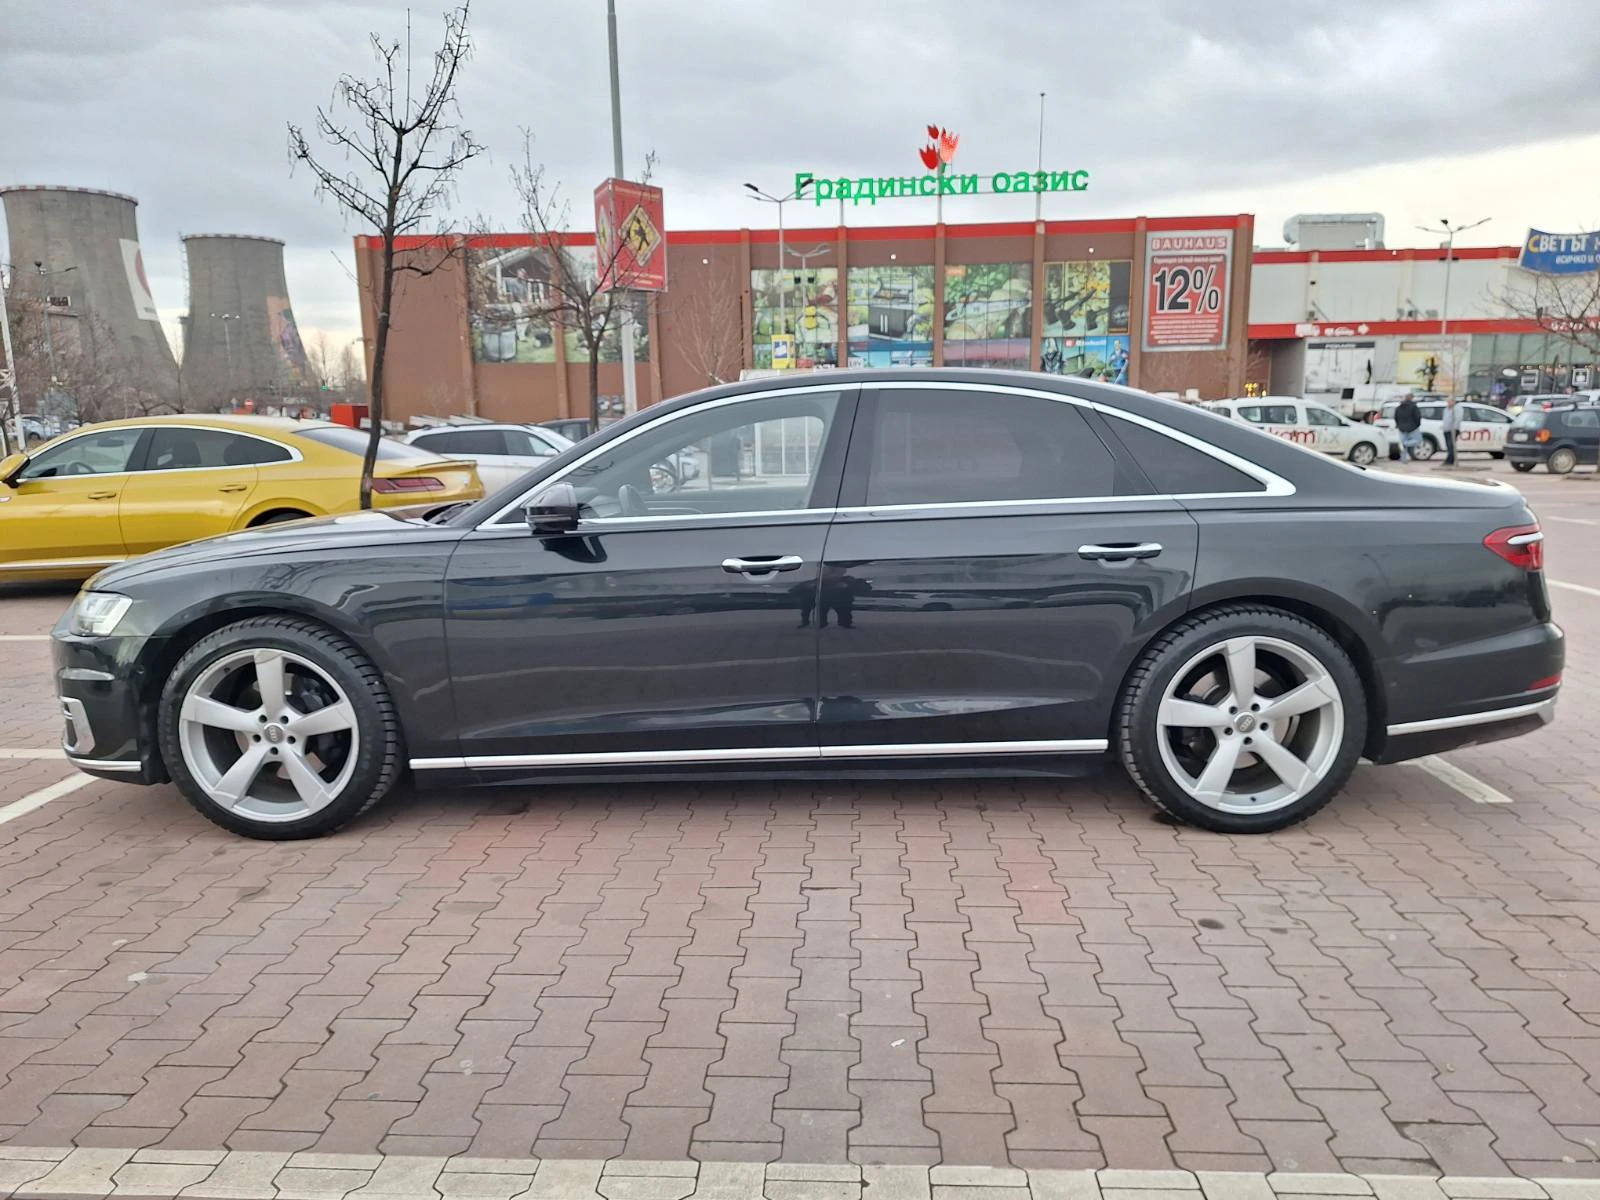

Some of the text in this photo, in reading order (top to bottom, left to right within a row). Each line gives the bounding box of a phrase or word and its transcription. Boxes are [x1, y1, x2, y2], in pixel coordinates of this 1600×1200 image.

[795, 170, 1089, 206] Градински оазис
[1152, 237, 1227, 250] BAUHAUS
[1528, 235, 1590, 253] СВЕТЪТ
[1154, 265, 1220, 313] 12%
